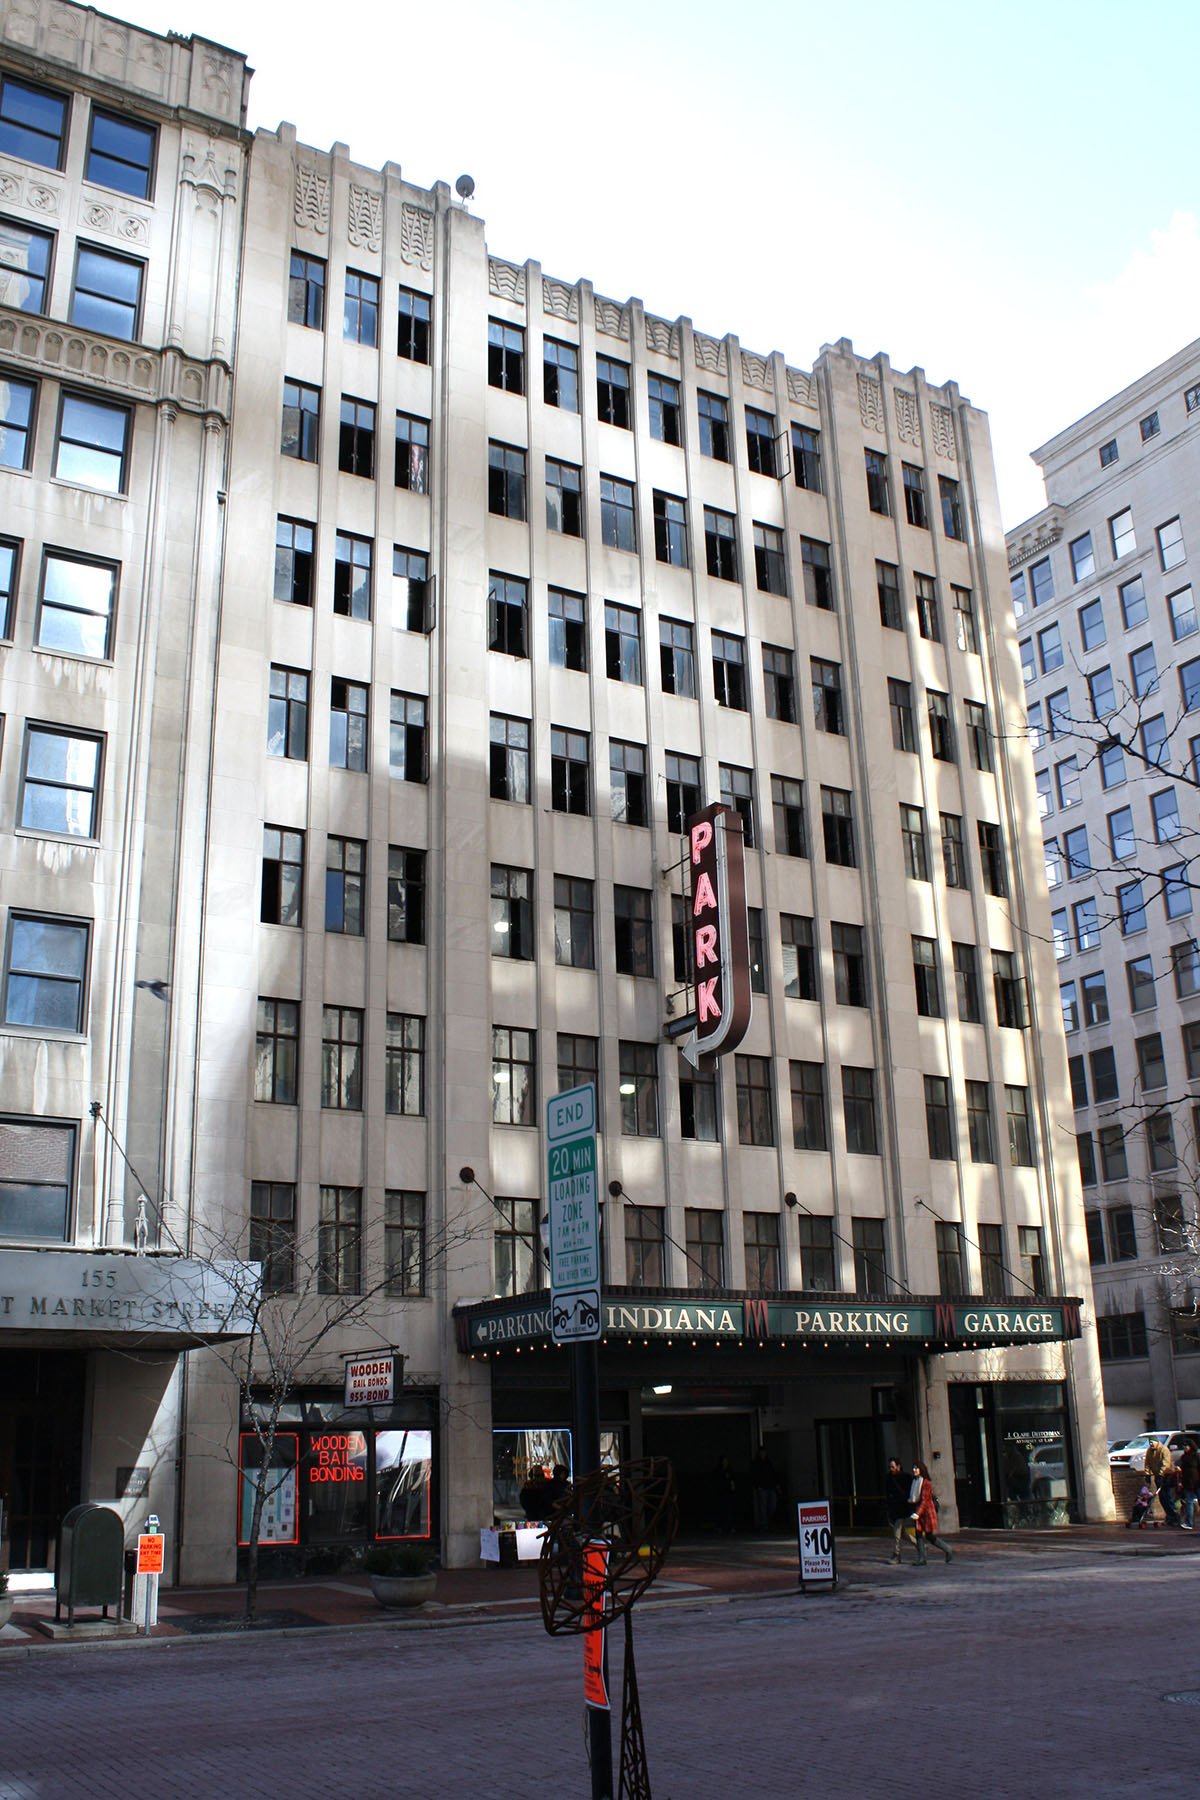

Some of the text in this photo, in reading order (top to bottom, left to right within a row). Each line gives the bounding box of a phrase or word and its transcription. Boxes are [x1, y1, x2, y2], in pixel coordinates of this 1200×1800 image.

[691, 821, 722, 1024] PARK
[557, 1103, 583, 1127] END
[553, 1146, 592, 1176] 20 MIN
[555, 1176, 590, 1201] LOADING
[562, 1200, 583, 1222] ZONE
[559, 1253, 590, 1267] FREE PARKING
[81, 1269, 117, 1288] 155
[30, 1296, 137, 1318] MARKET
[606, 1306, 1055, 1333] INDIANA PARKING GARAGE
[350, 1361, 392, 1377] WOODEN
[353, 1377, 388, 1388] BAIL BONDS
[350, 1389, 390, 1402] 955-BOND
[310, 1435, 366, 1451] WOODEN
[319, 1450, 355, 1466] BAIL
[310, 1466, 365, 1482] BONDING
[802, 1514, 827, 1523] PARKING
[804, 1527, 831, 1556] $10
[811, 1566, 831, 1574] Advance
[821, 1559, 830, 1567] Pay
